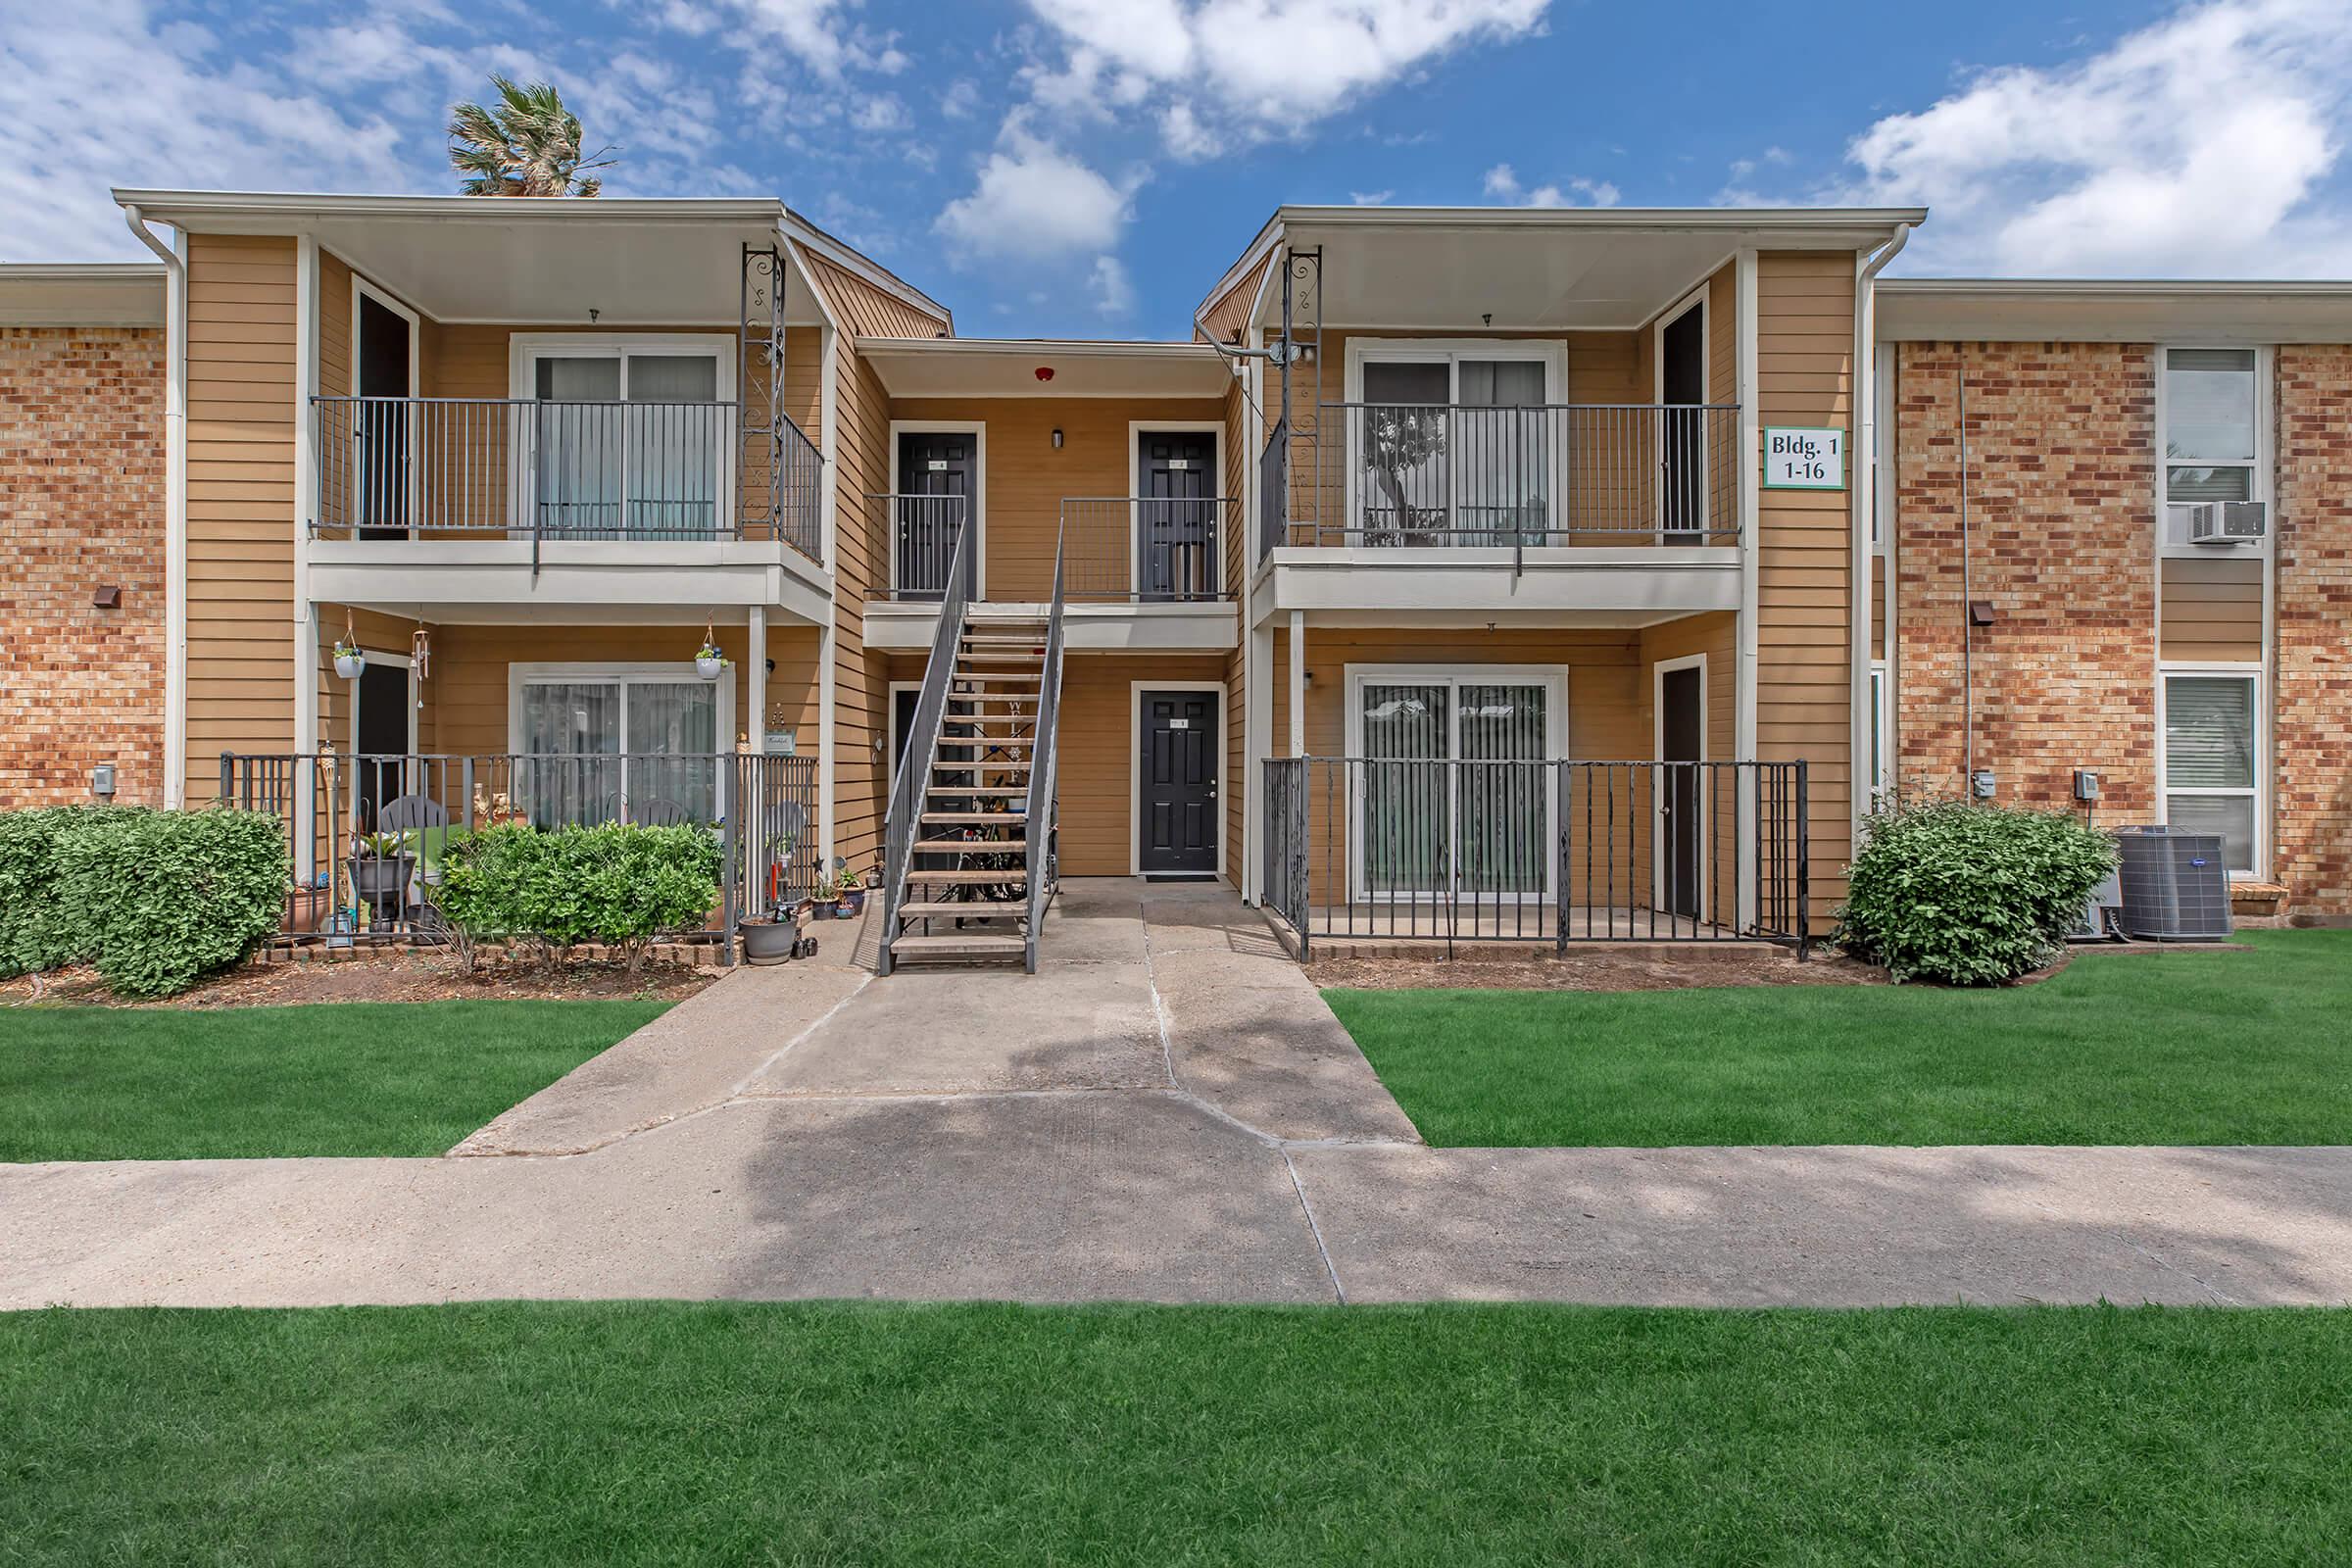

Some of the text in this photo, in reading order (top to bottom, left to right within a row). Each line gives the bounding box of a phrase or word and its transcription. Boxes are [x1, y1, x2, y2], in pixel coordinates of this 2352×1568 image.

[1772, 435, 1838, 461] Bldg. 1
[1785, 462, 1825, 479] 1-16
